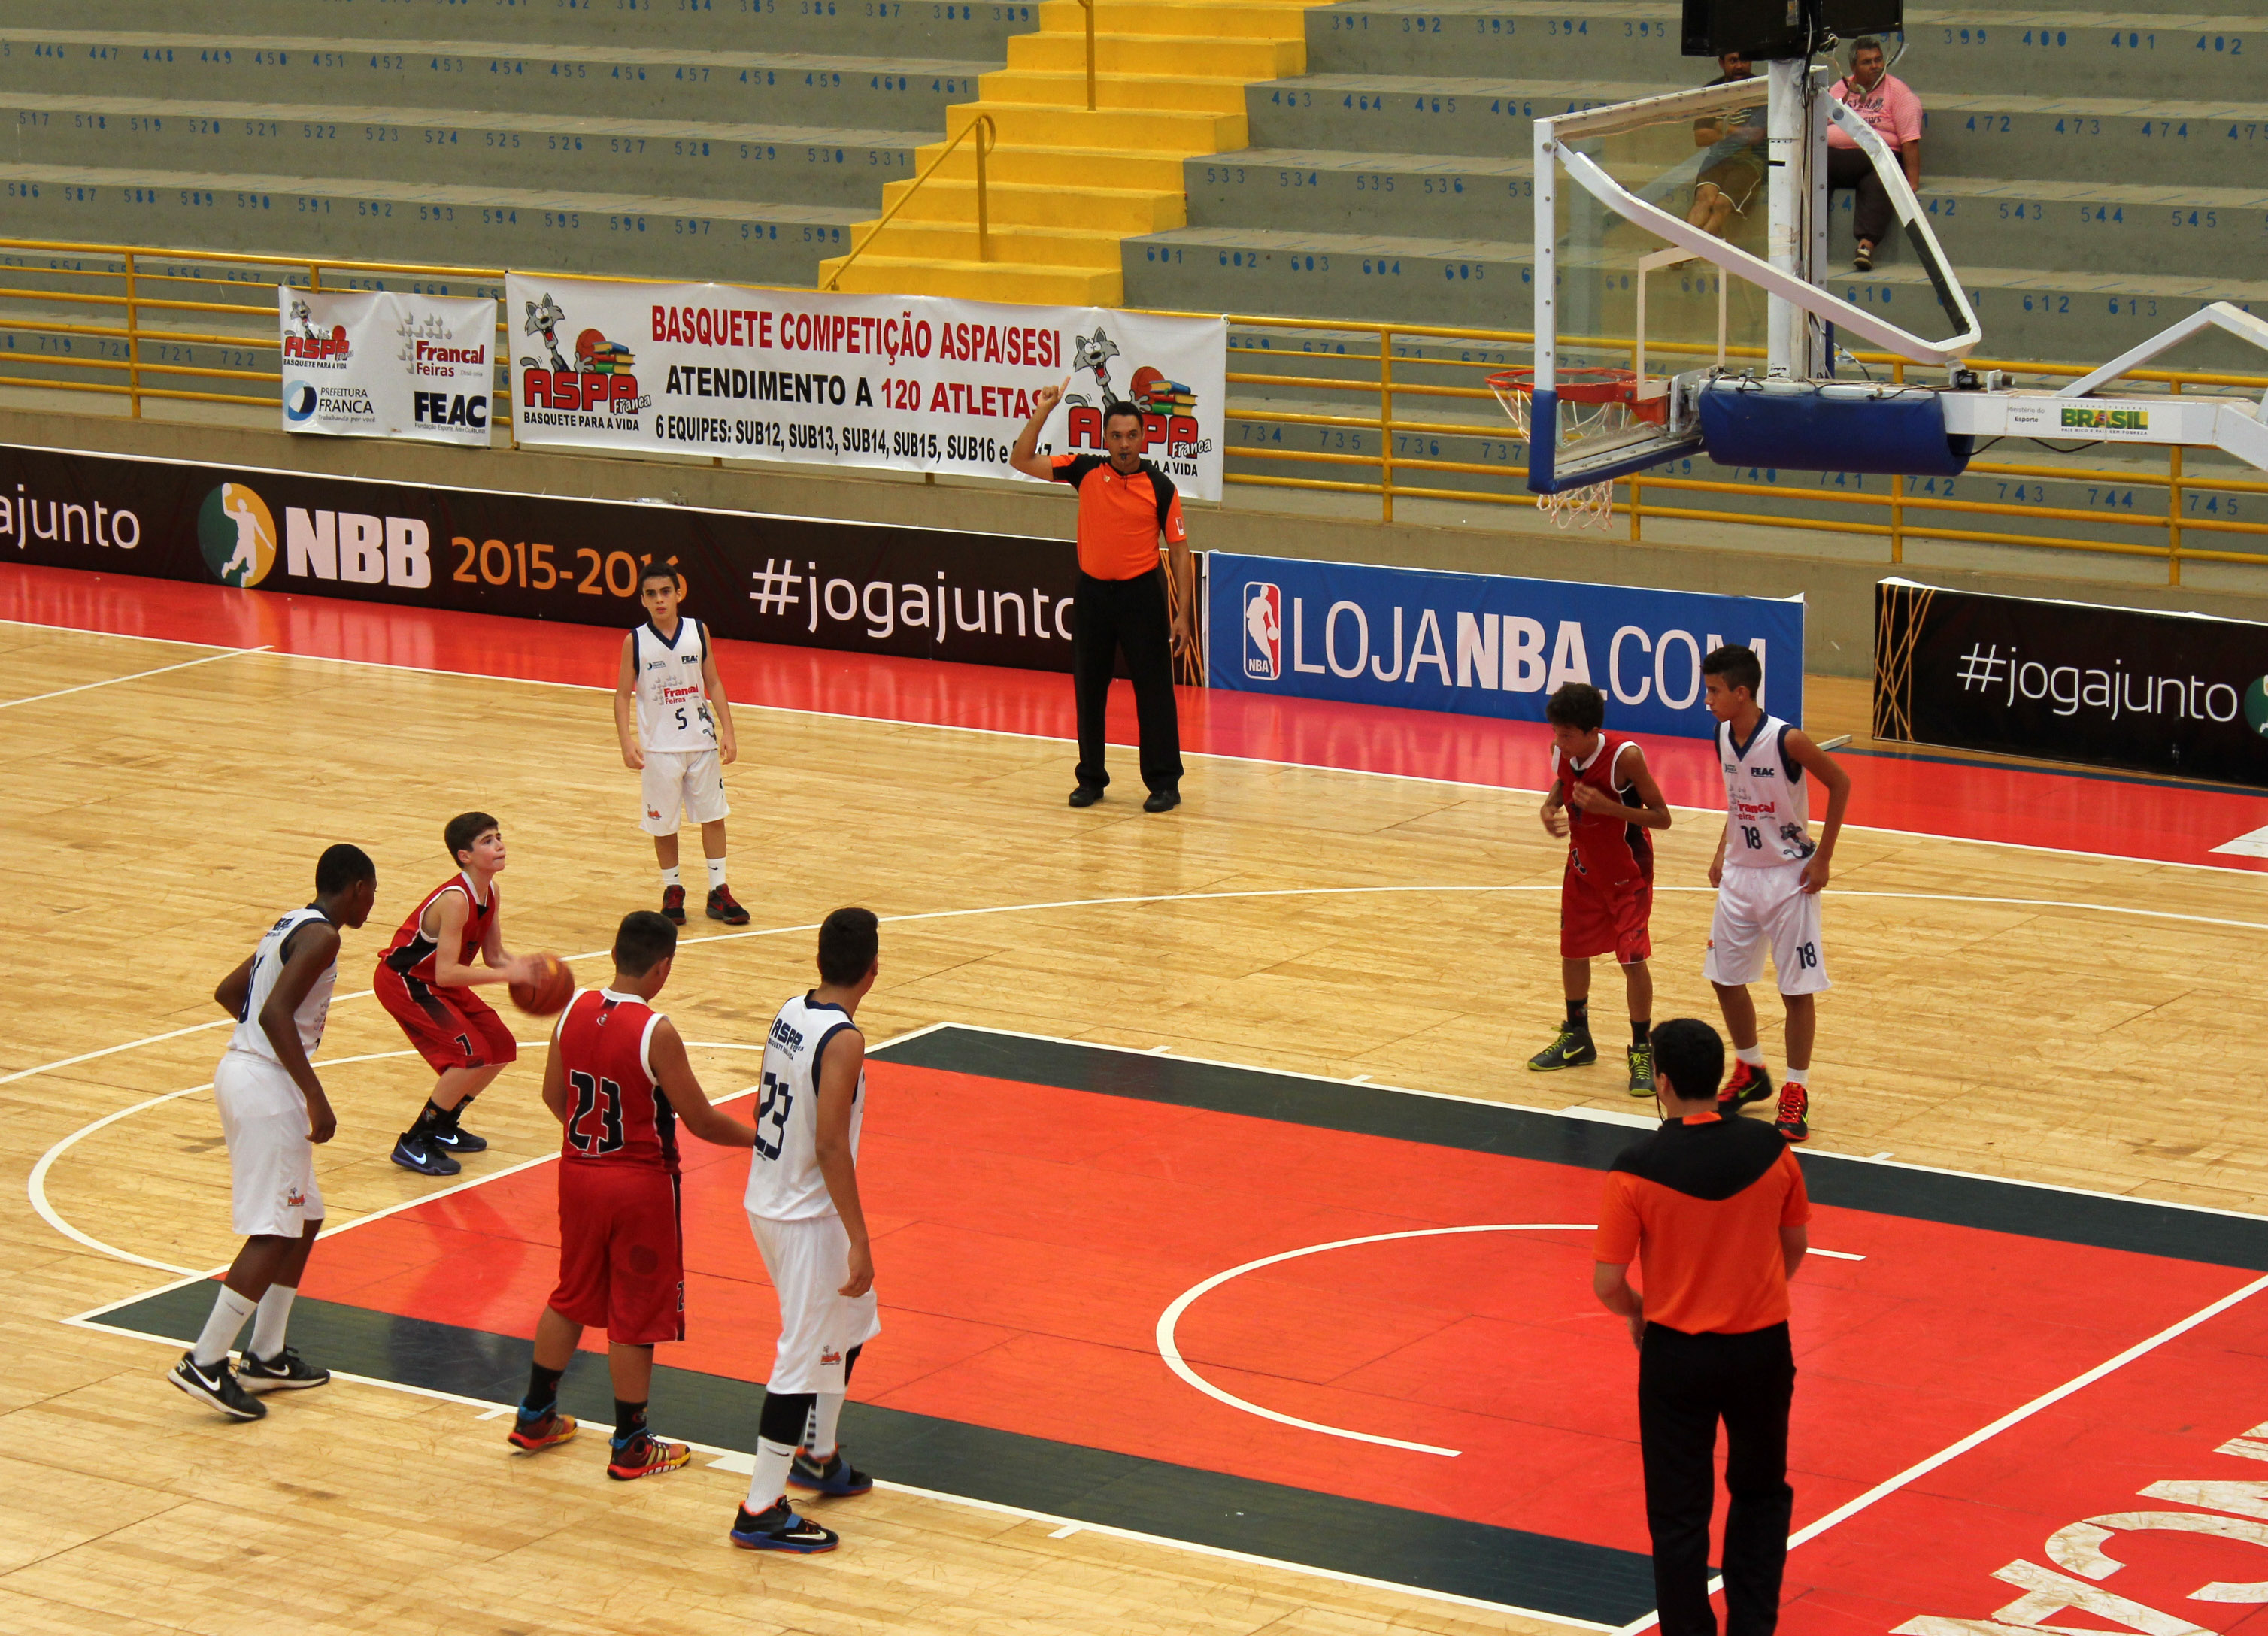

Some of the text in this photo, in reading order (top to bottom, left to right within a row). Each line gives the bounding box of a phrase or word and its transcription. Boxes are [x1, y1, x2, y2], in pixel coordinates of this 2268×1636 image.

[935, 5, 1029, 21] 388 389
[1403, 16, 1665, 37] 392 393 394 395
[1945, 29, 2242, 55] 399 400 401 402
[34, 44, 967, 93] 446 447 448 449 450 451 452 453 454 455 456 457 458 459 460 461
[1272, 91, 1532, 117] 463 464 465 466
[1966, 115, 2188, 138] 472 473 474
[75, 114, 905, 166] 518 519 520 522 524 526 528 529 530 531
[1207, 167, 1464, 193] 533 534 535 536
[8, 183, 840, 243] 586 587 588 589 590 591 592 593 594 595 596 597 598 599
[2000, 203, 2216, 227] 543 544 545
[1146, 247, 1483, 280] 601 602 603 604 605
[1846, 286, 2156, 316] 610 612 613
[652, 305, 1060, 368] BASQUETE COMPETIÇÃO ASPA/SESI
[416, 340, 484, 365] Francal
[417, 362, 454, 377] Feiras
[320, 387, 368, 398] PREFEITURA
[524, 368, 639, 414] ASPA
[666, 365, 846, 405] ATENDIMENTO
[855, 377, 873, 407] A
[881, 377, 920, 411] 120
[319, 398, 374, 414] FRANCA
[414, 391, 487, 429] FEAC
[613, 395, 652, 415] Franca
[524, 412, 640, 431] BASQUETE PARA A VIDA
[2062, 408, 2148, 430] BRASIL
[656, 415, 663, 438] 6
[668, 416, 732, 443] EQUIPES:
[736, 420, 785, 452] SUB12,
[789, 423, 838, 456] SUB13,
[842, 427, 890, 460] SUB14,
[894, 431, 941, 464] SUB15,
[947, 435, 995, 463] SUB16
[999, 445, 1008, 464] e
[1069, 407, 1199, 459] APA
[1242, 424, 1522, 460] 734 735 736 737
[1171, 439, 1213, 459] Franca
[1172, 462, 1199, 477] VIDA
[1905, 472, 2238, 515] 742 743 744 745
[286, 507, 432, 589] NBB
[452, 536, 687, 604] 2015-20
[750, 558, 1075, 644] #jogajunto
[1248, 658, 1269, 673] NBA
[1957, 643, 2238, 722] #jogajunto
[675, 707, 687, 730] 5
[1751, 767, 1775, 776] FEAC
[1737, 813, 1756, 822] eiras
[1738, 801, 1775, 813] rancal
[1740, 824, 1763, 850] 18
[1796, 941, 1817, 970] 18
[454, 1033, 473, 1056] 7
[568, 1069, 625, 1154] 23
[753, 1071, 793, 1161] 23
